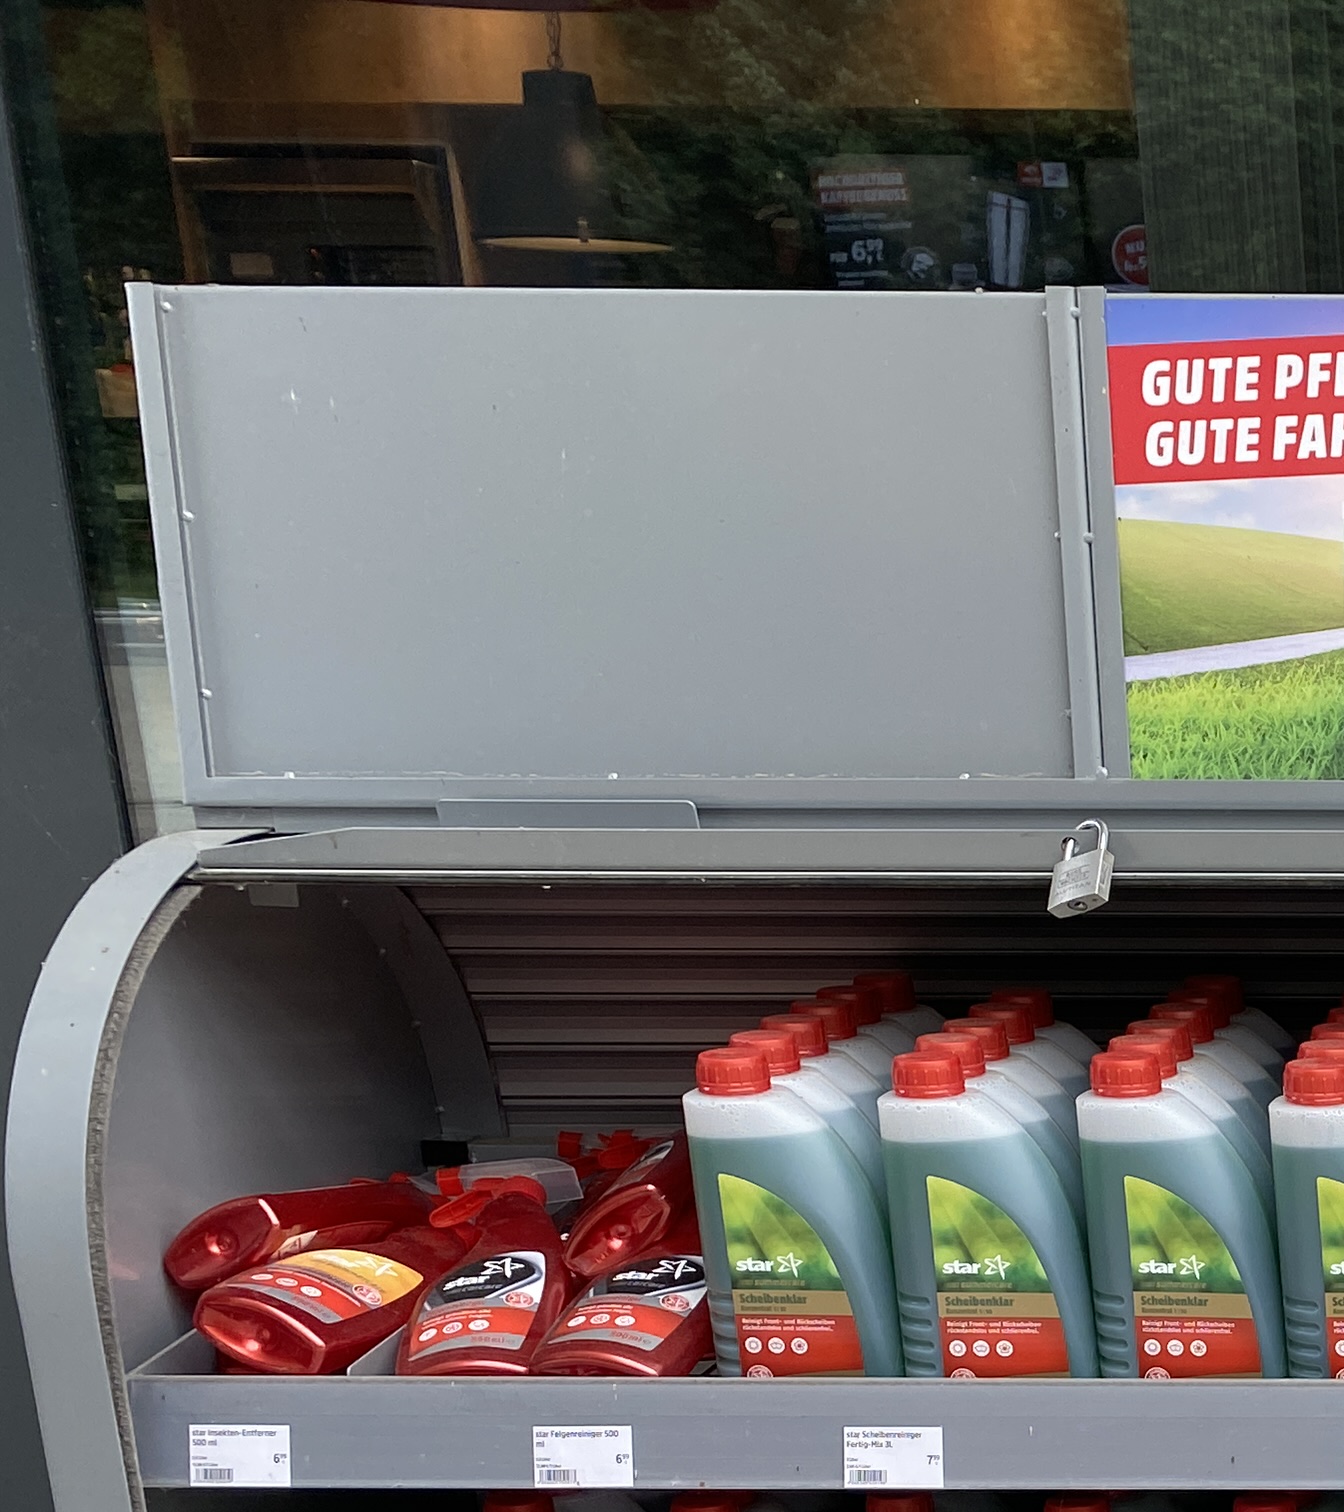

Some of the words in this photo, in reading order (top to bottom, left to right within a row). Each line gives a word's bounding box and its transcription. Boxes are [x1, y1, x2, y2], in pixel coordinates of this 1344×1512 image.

[1141, 354, 1263, 406] GUTE
[1145, 415, 1262, 467] GUTE
[735, 1256, 774, 1273] star
[941, 1259, 981, 1276] star
[1137, 1259, 1177, 1276] star
[613, 1270, 659, 1284] star
